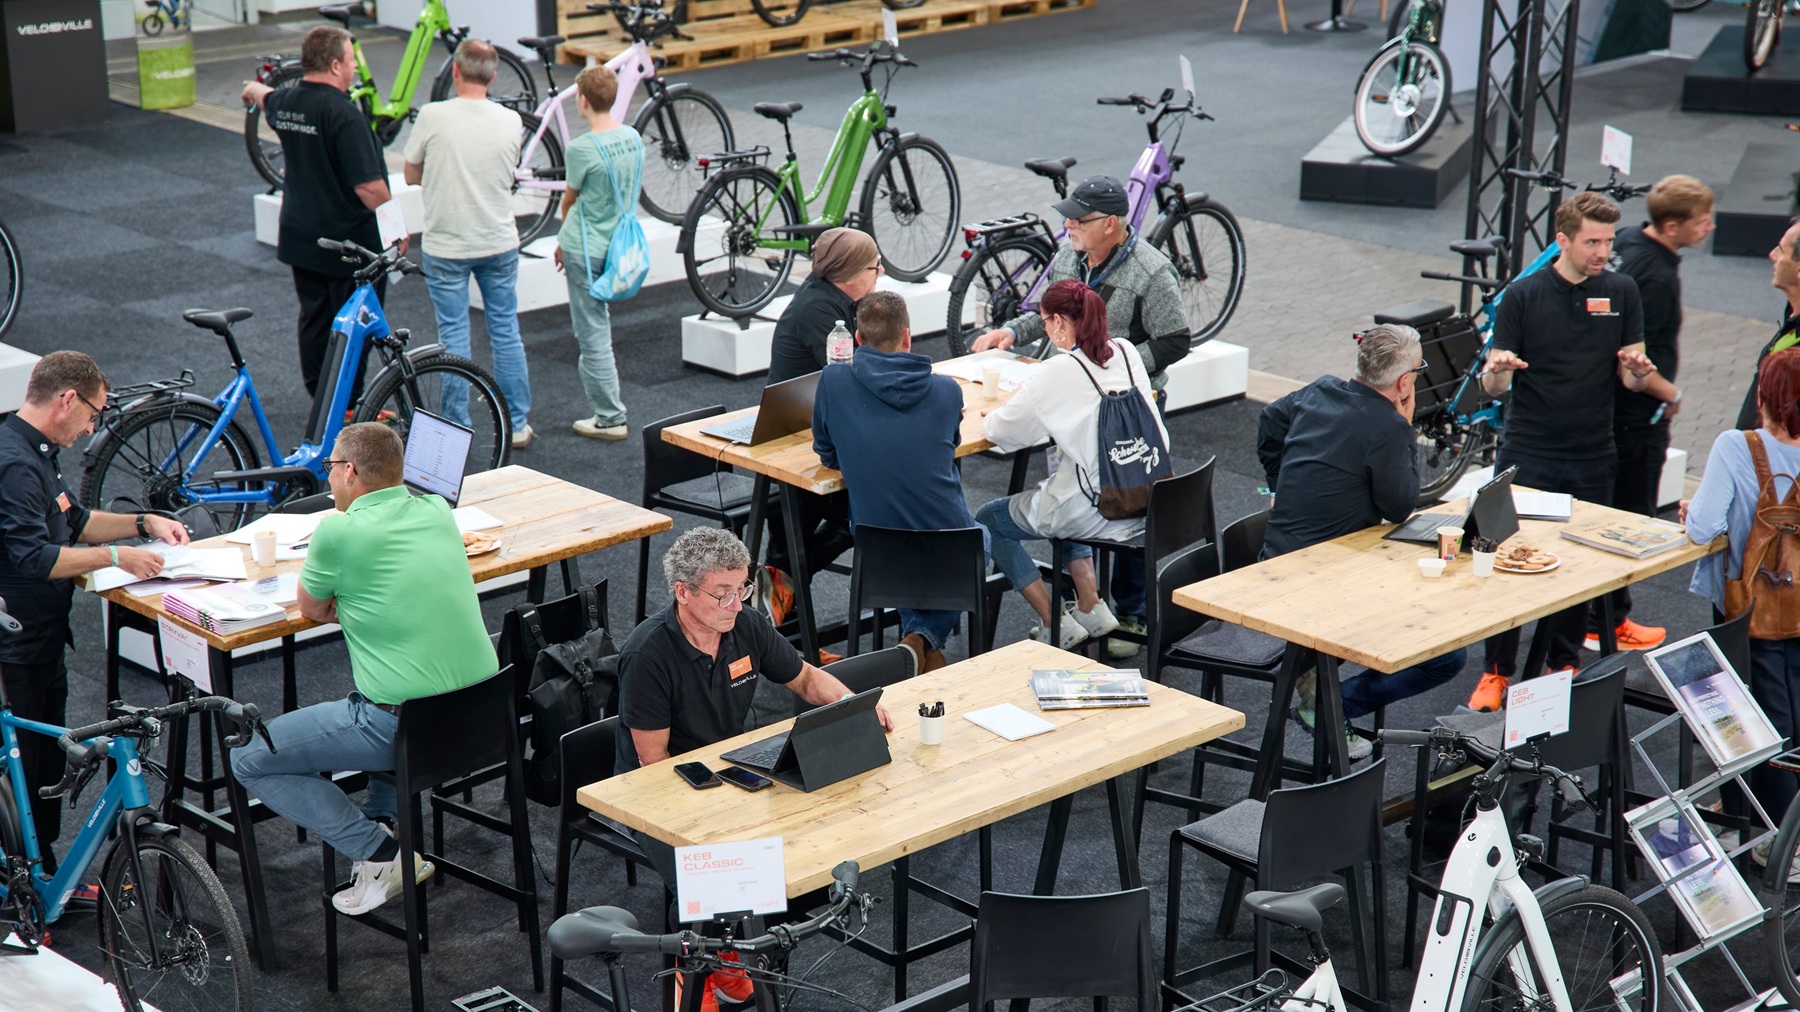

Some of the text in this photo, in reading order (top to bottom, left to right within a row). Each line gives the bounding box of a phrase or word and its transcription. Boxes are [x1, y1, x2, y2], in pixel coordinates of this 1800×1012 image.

[1511, 692, 1535, 706] LIGHT
[1512, 687, 1529, 698] CEB
[1700, 695, 1726, 709] NOTHING
[683, 852, 712, 862] KEB
[684, 858, 744, 871] CLASSIC
